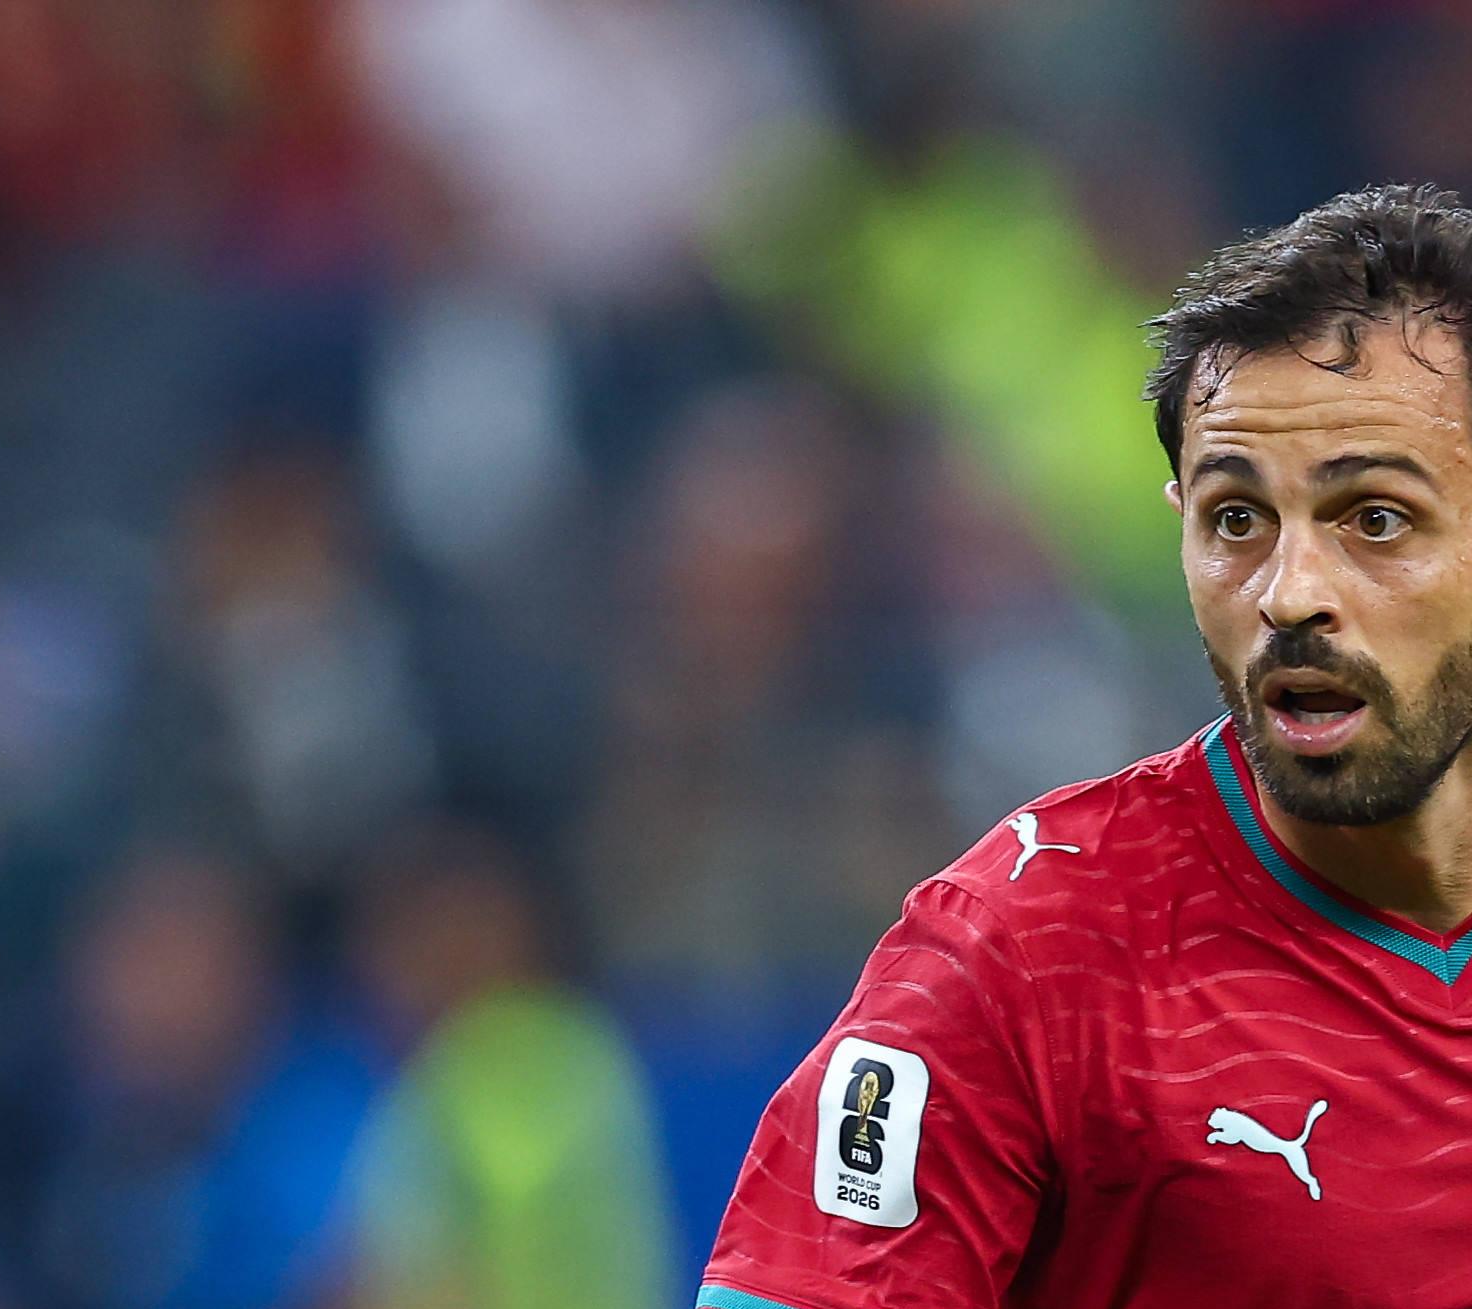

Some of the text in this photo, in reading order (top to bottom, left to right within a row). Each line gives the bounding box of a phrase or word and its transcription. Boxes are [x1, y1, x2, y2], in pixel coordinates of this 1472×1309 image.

[851, 1148, 872, 1165] FIFA
[838, 1172, 881, 1191] WORLD CUP
[837, 1185, 880, 1211] 2026
